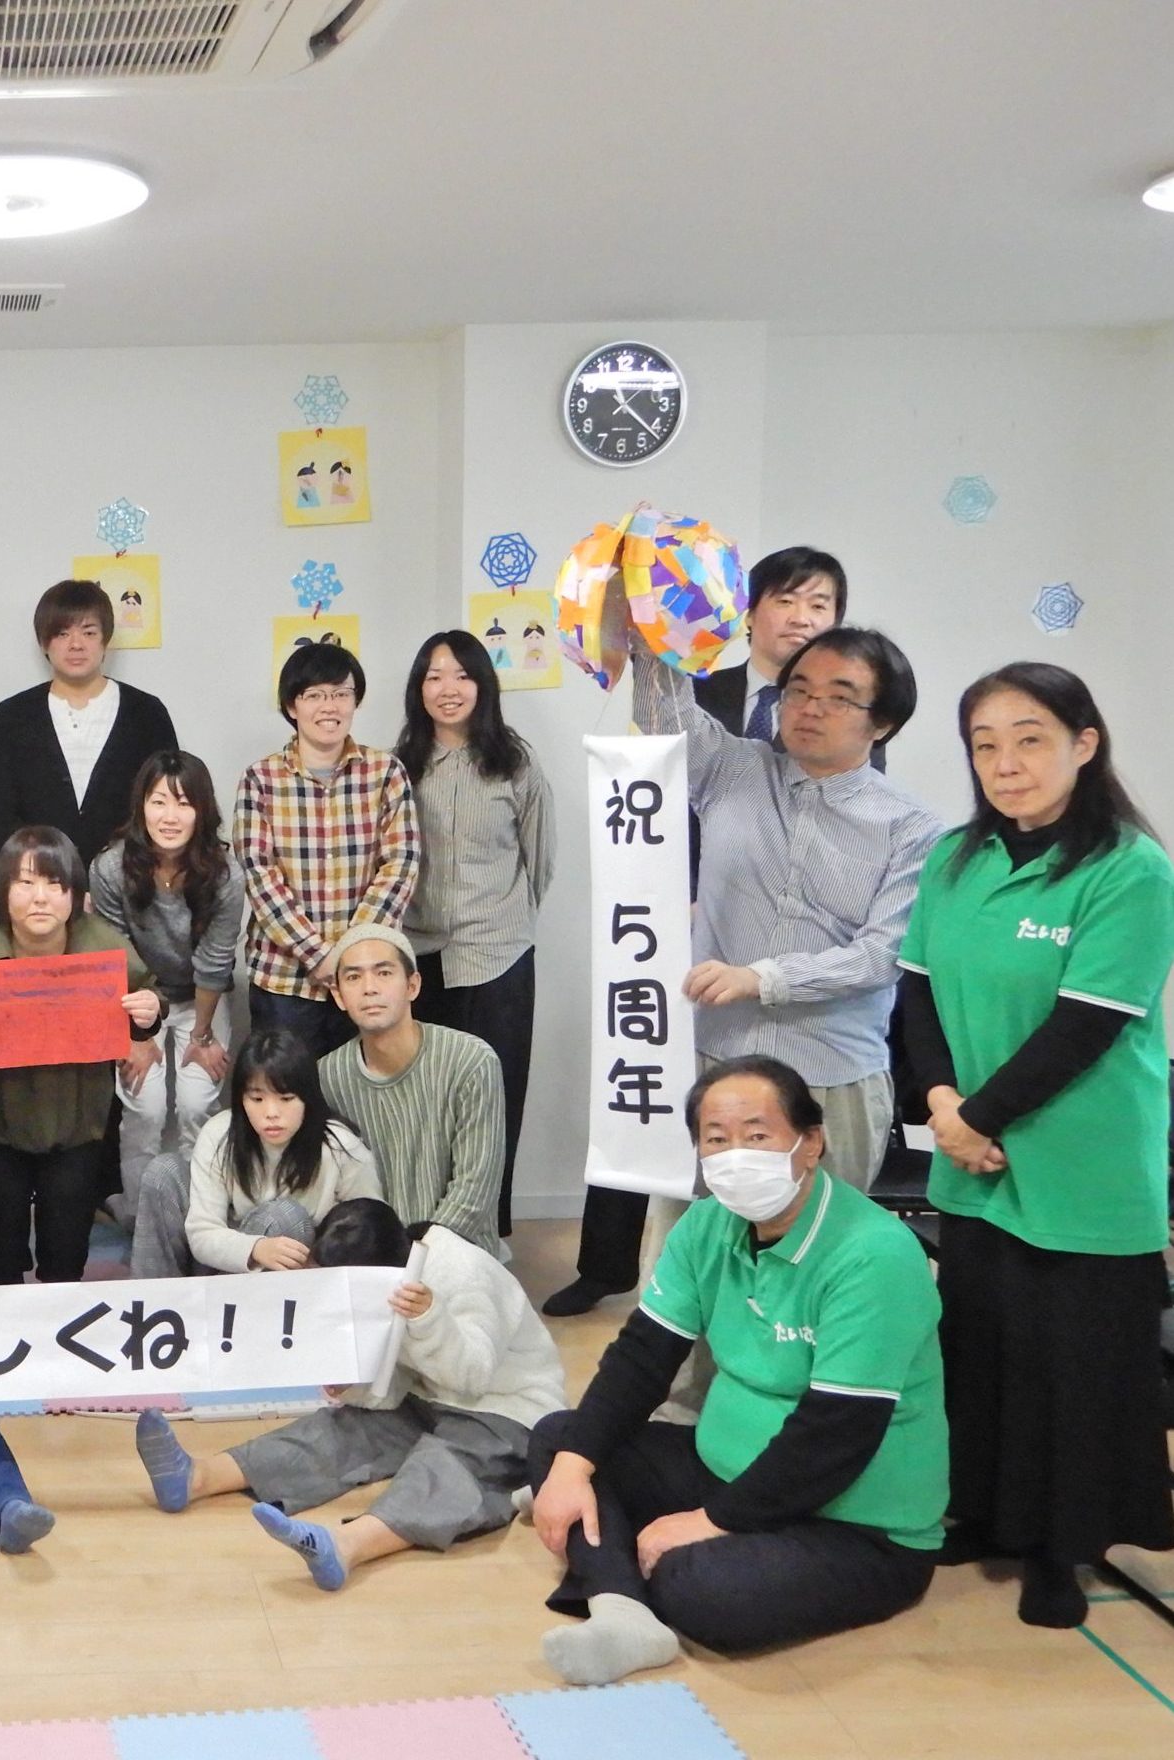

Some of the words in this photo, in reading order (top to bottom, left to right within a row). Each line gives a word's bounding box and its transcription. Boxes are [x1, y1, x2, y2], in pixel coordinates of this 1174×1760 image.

[616, 355, 634, 371] 12
[577, 398, 588, 413] 9
[659, 397, 669, 412] 3
[583, 418, 593, 434] 8
[651, 417, 662, 433] 4
[597, 433, 608, 449] 7
[616, 438, 626, 453] 6
[636, 432, 647, 448] 5
[606, 778, 665, 845] 祝
[607, 902, 674, 1125] 5周年
